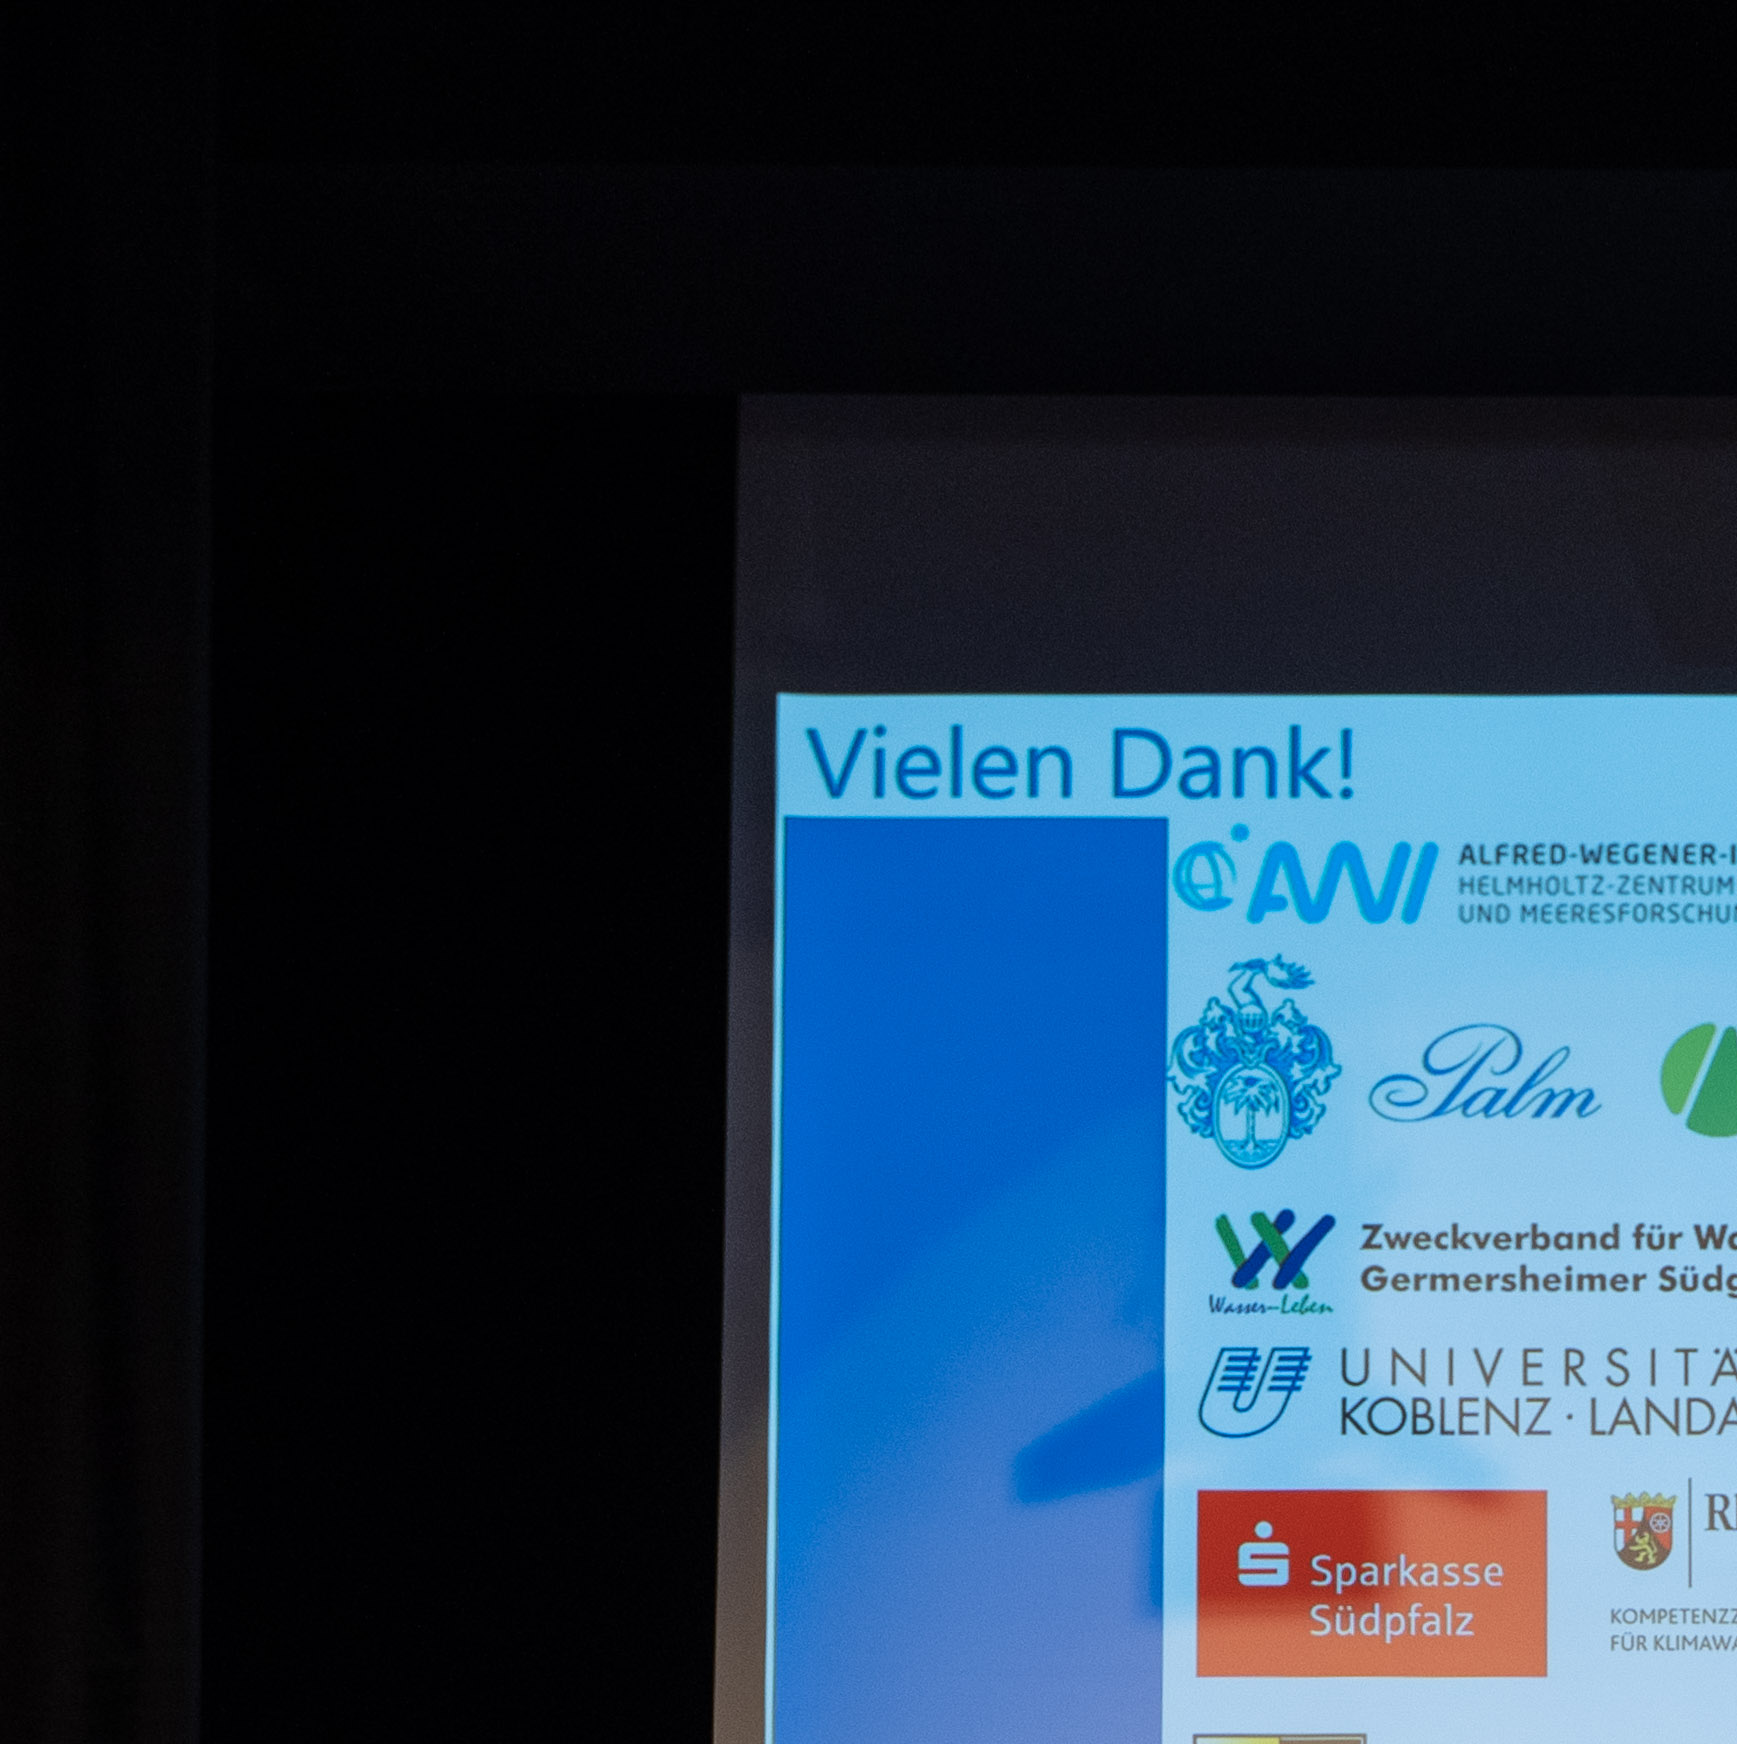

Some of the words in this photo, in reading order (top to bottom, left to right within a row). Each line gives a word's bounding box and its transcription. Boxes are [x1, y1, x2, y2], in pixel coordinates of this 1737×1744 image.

[806, 723, 1074, 799] Vielen
[1112, 723, 1355, 799] Dank!
[1458, 875, 1736, 897] HELMHOLTZ-ZENTRUM
[1458, 904, 1511, 924] UND
[1368, 1022, 1603, 1122] Palm
[1360, 1222, 1626, 1253] Zweckverband
[1630, 1222, 1685, 1253] für
[1360, 1264, 1647, 1295] Germersheimer
[1339, 1396, 1554, 1437] KOBLENZ
[1310, 1554, 1504, 1593] Sparkasse
[1310, 1602, 1475, 1644] Südpfalz
[1610, 1630, 1648, 1652] FÜR
